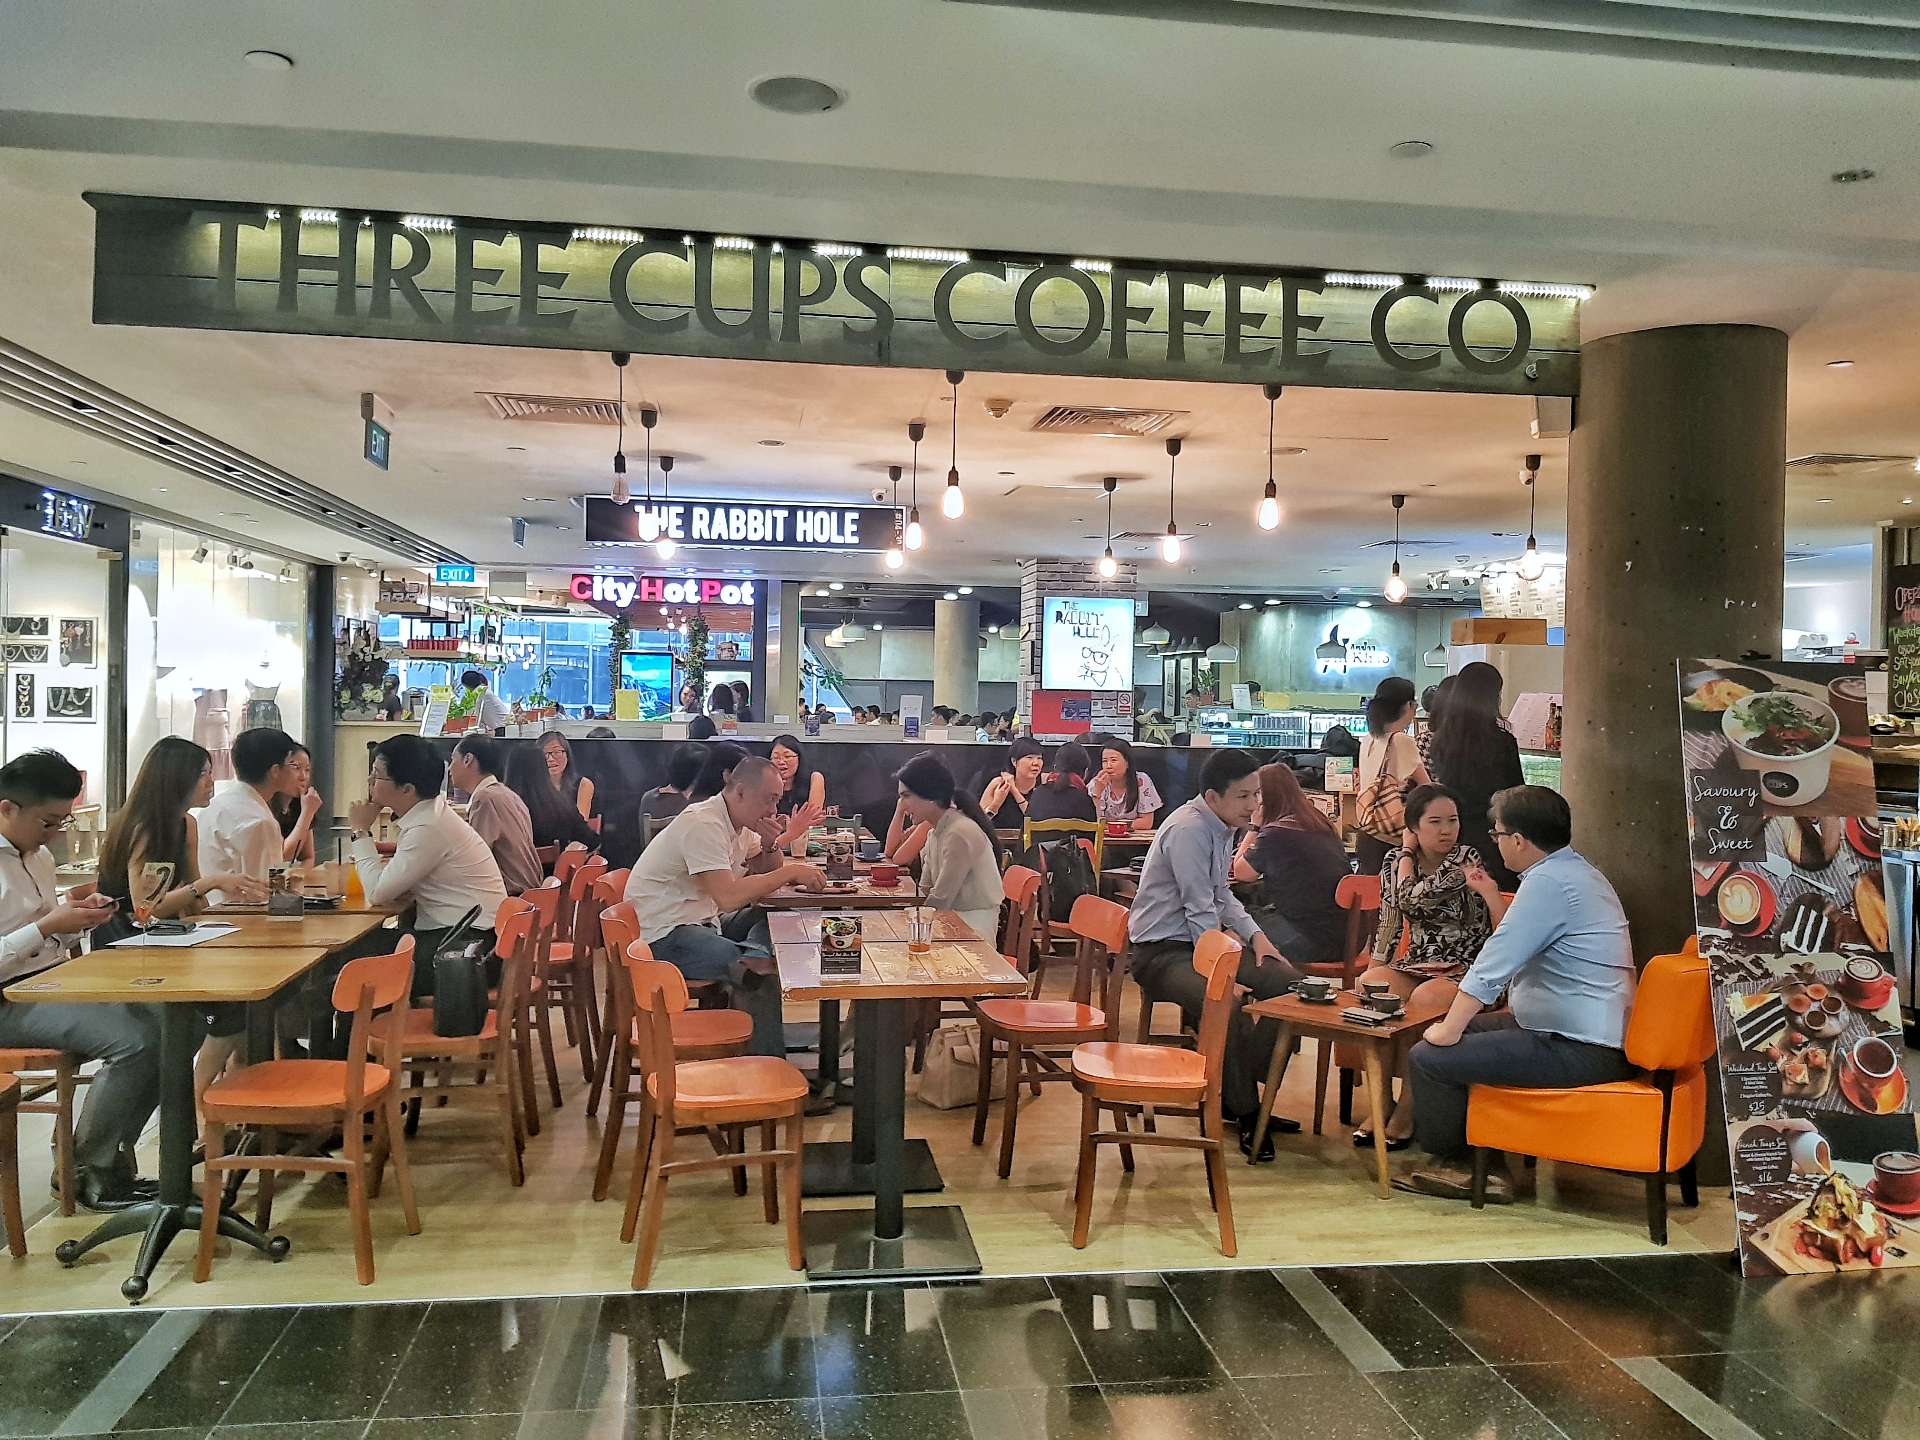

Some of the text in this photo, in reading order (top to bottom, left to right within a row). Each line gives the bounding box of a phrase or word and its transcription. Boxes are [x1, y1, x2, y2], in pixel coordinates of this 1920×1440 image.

[188, 208, 579, 328] THREE
[610, 238, 895, 346] CUPS
[933, 260, 1332, 366] COFFEE
[371, 429, 385, 461] EXIT
[691, 507, 788, 541] RABBIT
[796, 510, 860, 544] HOLE
[440, 568, 464, 581] EXIT
[570, 574, 637, 608] City
[1694, 775, 1759, 807] Savoury
[1717, 805, 1739, 830] &
[1707, 827, 1753, 855] Sweet
